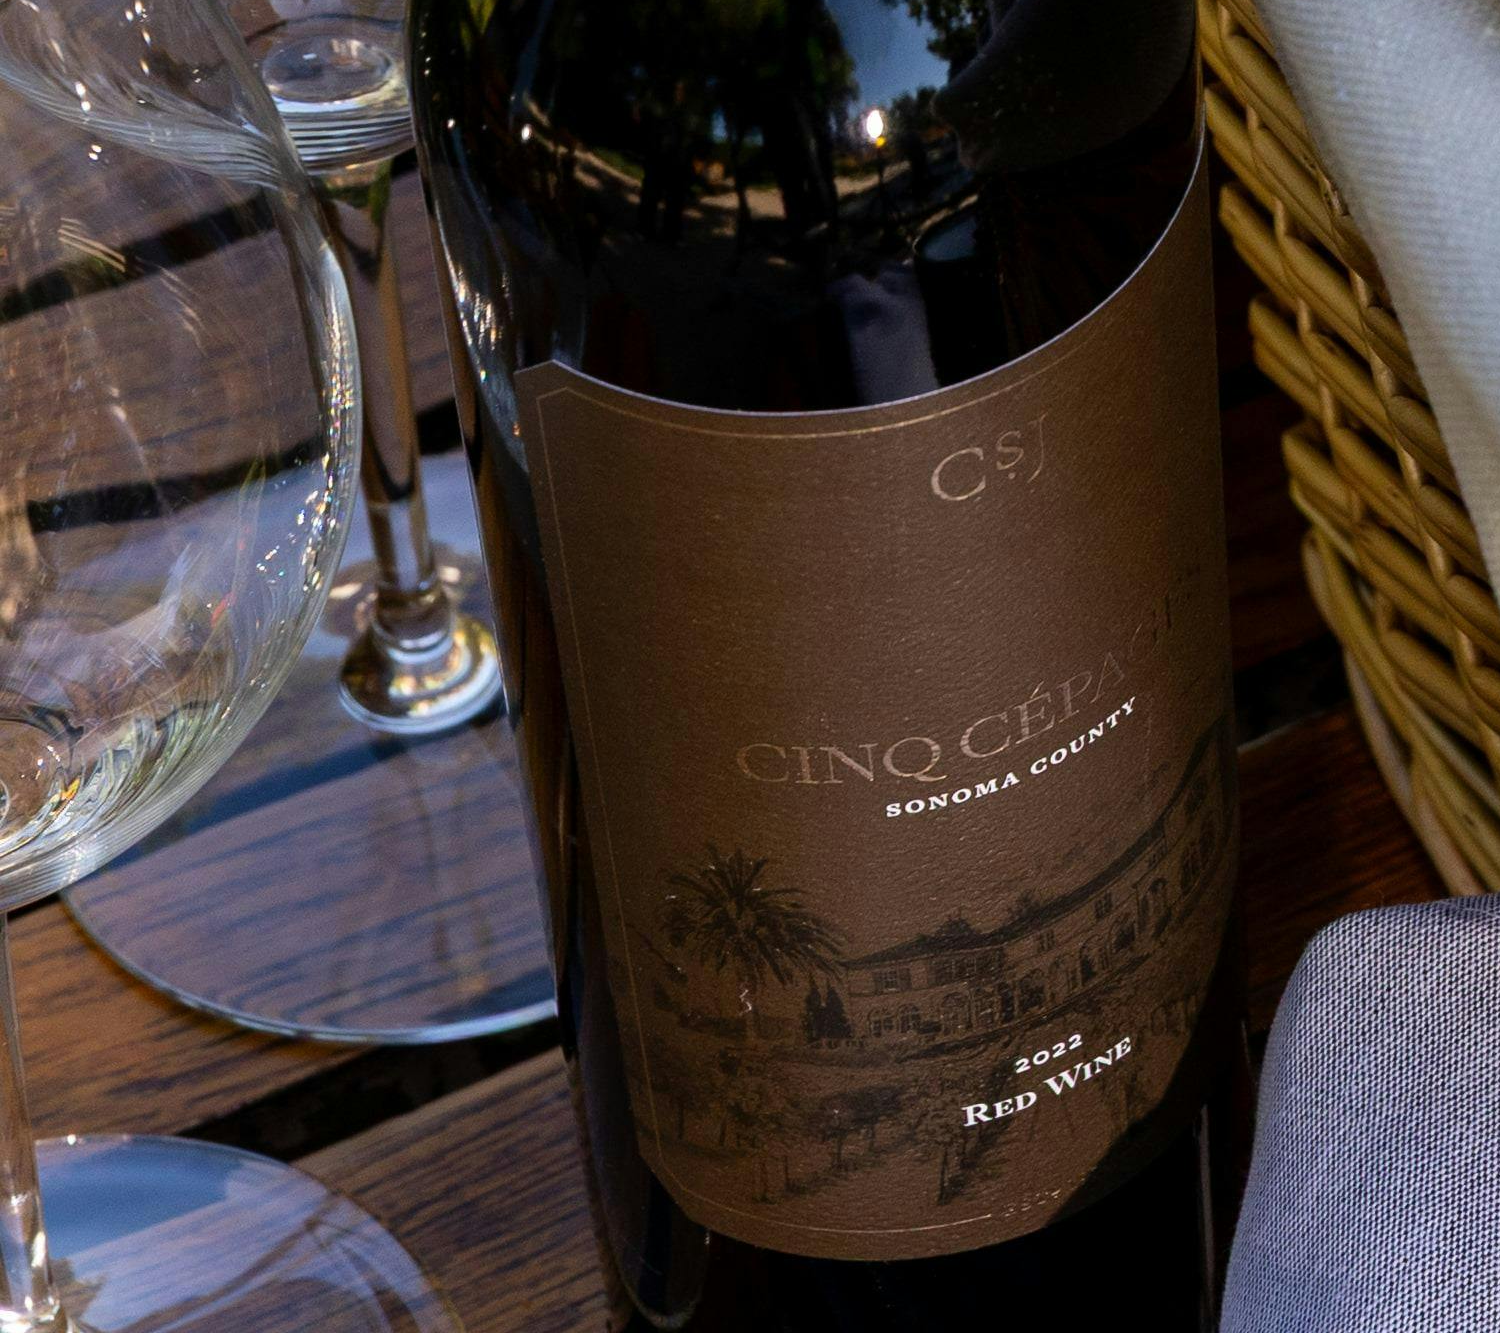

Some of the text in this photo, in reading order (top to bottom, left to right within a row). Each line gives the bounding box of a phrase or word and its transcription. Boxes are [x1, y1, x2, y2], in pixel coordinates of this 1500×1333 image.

[735, 735, 948, 786] CINQ
[886, 695, 1137, 819] SONOMA COUNTY
[960, 1035, 1133, 1128] RED WINE
[1014, 1033, 1084, 1075] 2022
